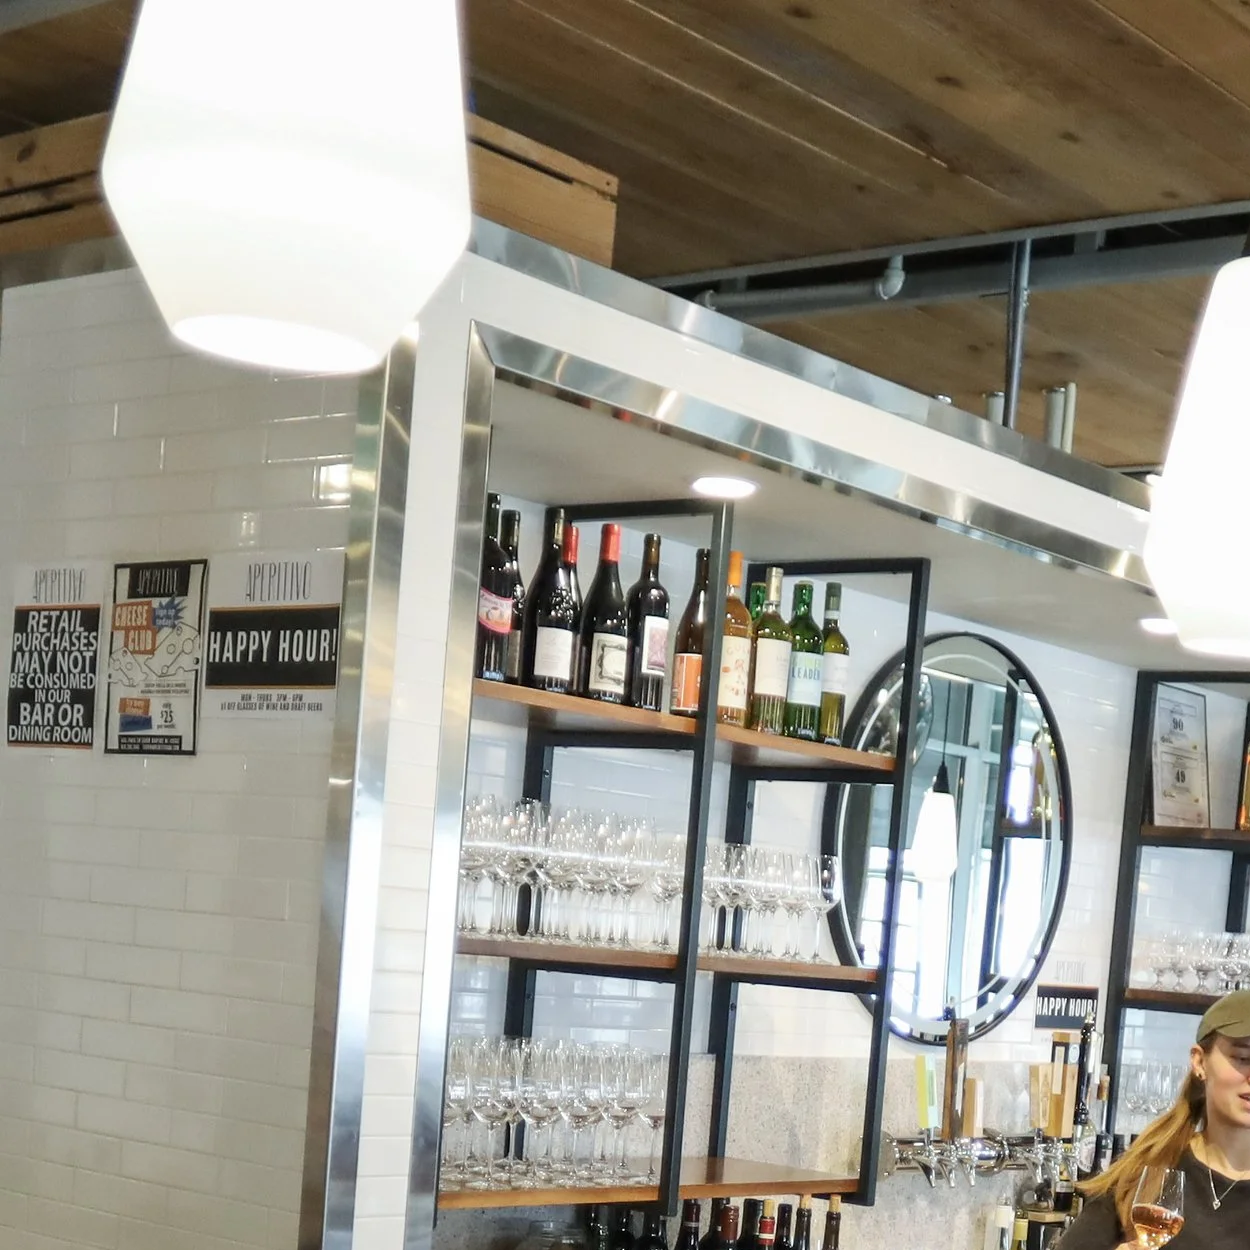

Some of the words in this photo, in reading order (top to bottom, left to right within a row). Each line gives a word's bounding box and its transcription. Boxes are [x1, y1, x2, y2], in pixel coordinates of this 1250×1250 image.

[245, 561, 312, 602] APERITIVO
[27, 610, 84, 633] RETAIL
[115, 604, 148, 627] CHEESE
[14, 631, 97, 651] PURCHASES
[128, 630, 153, 652] CLUB
[209, 630, 272, 663] HAPPY
[279, 628, 337, 662] HOUR!
[14, 652, 52, 673] MAY
[56, 652, 93, 674] NOT
[10, 673, 24, 688] BE
[26, 673, 96, 690] CONSUMED
[35, 689, 46, 702] IN
[48, 689, 71, 703] OUR
[19, 702, 54, 726] BAR
[58, 703, 84, 726] OR
[8, 725, 53, 742] DINING
[52, 727, 92, 743] ROOM
[1036, 996, 1067, 1016] HAPPY
